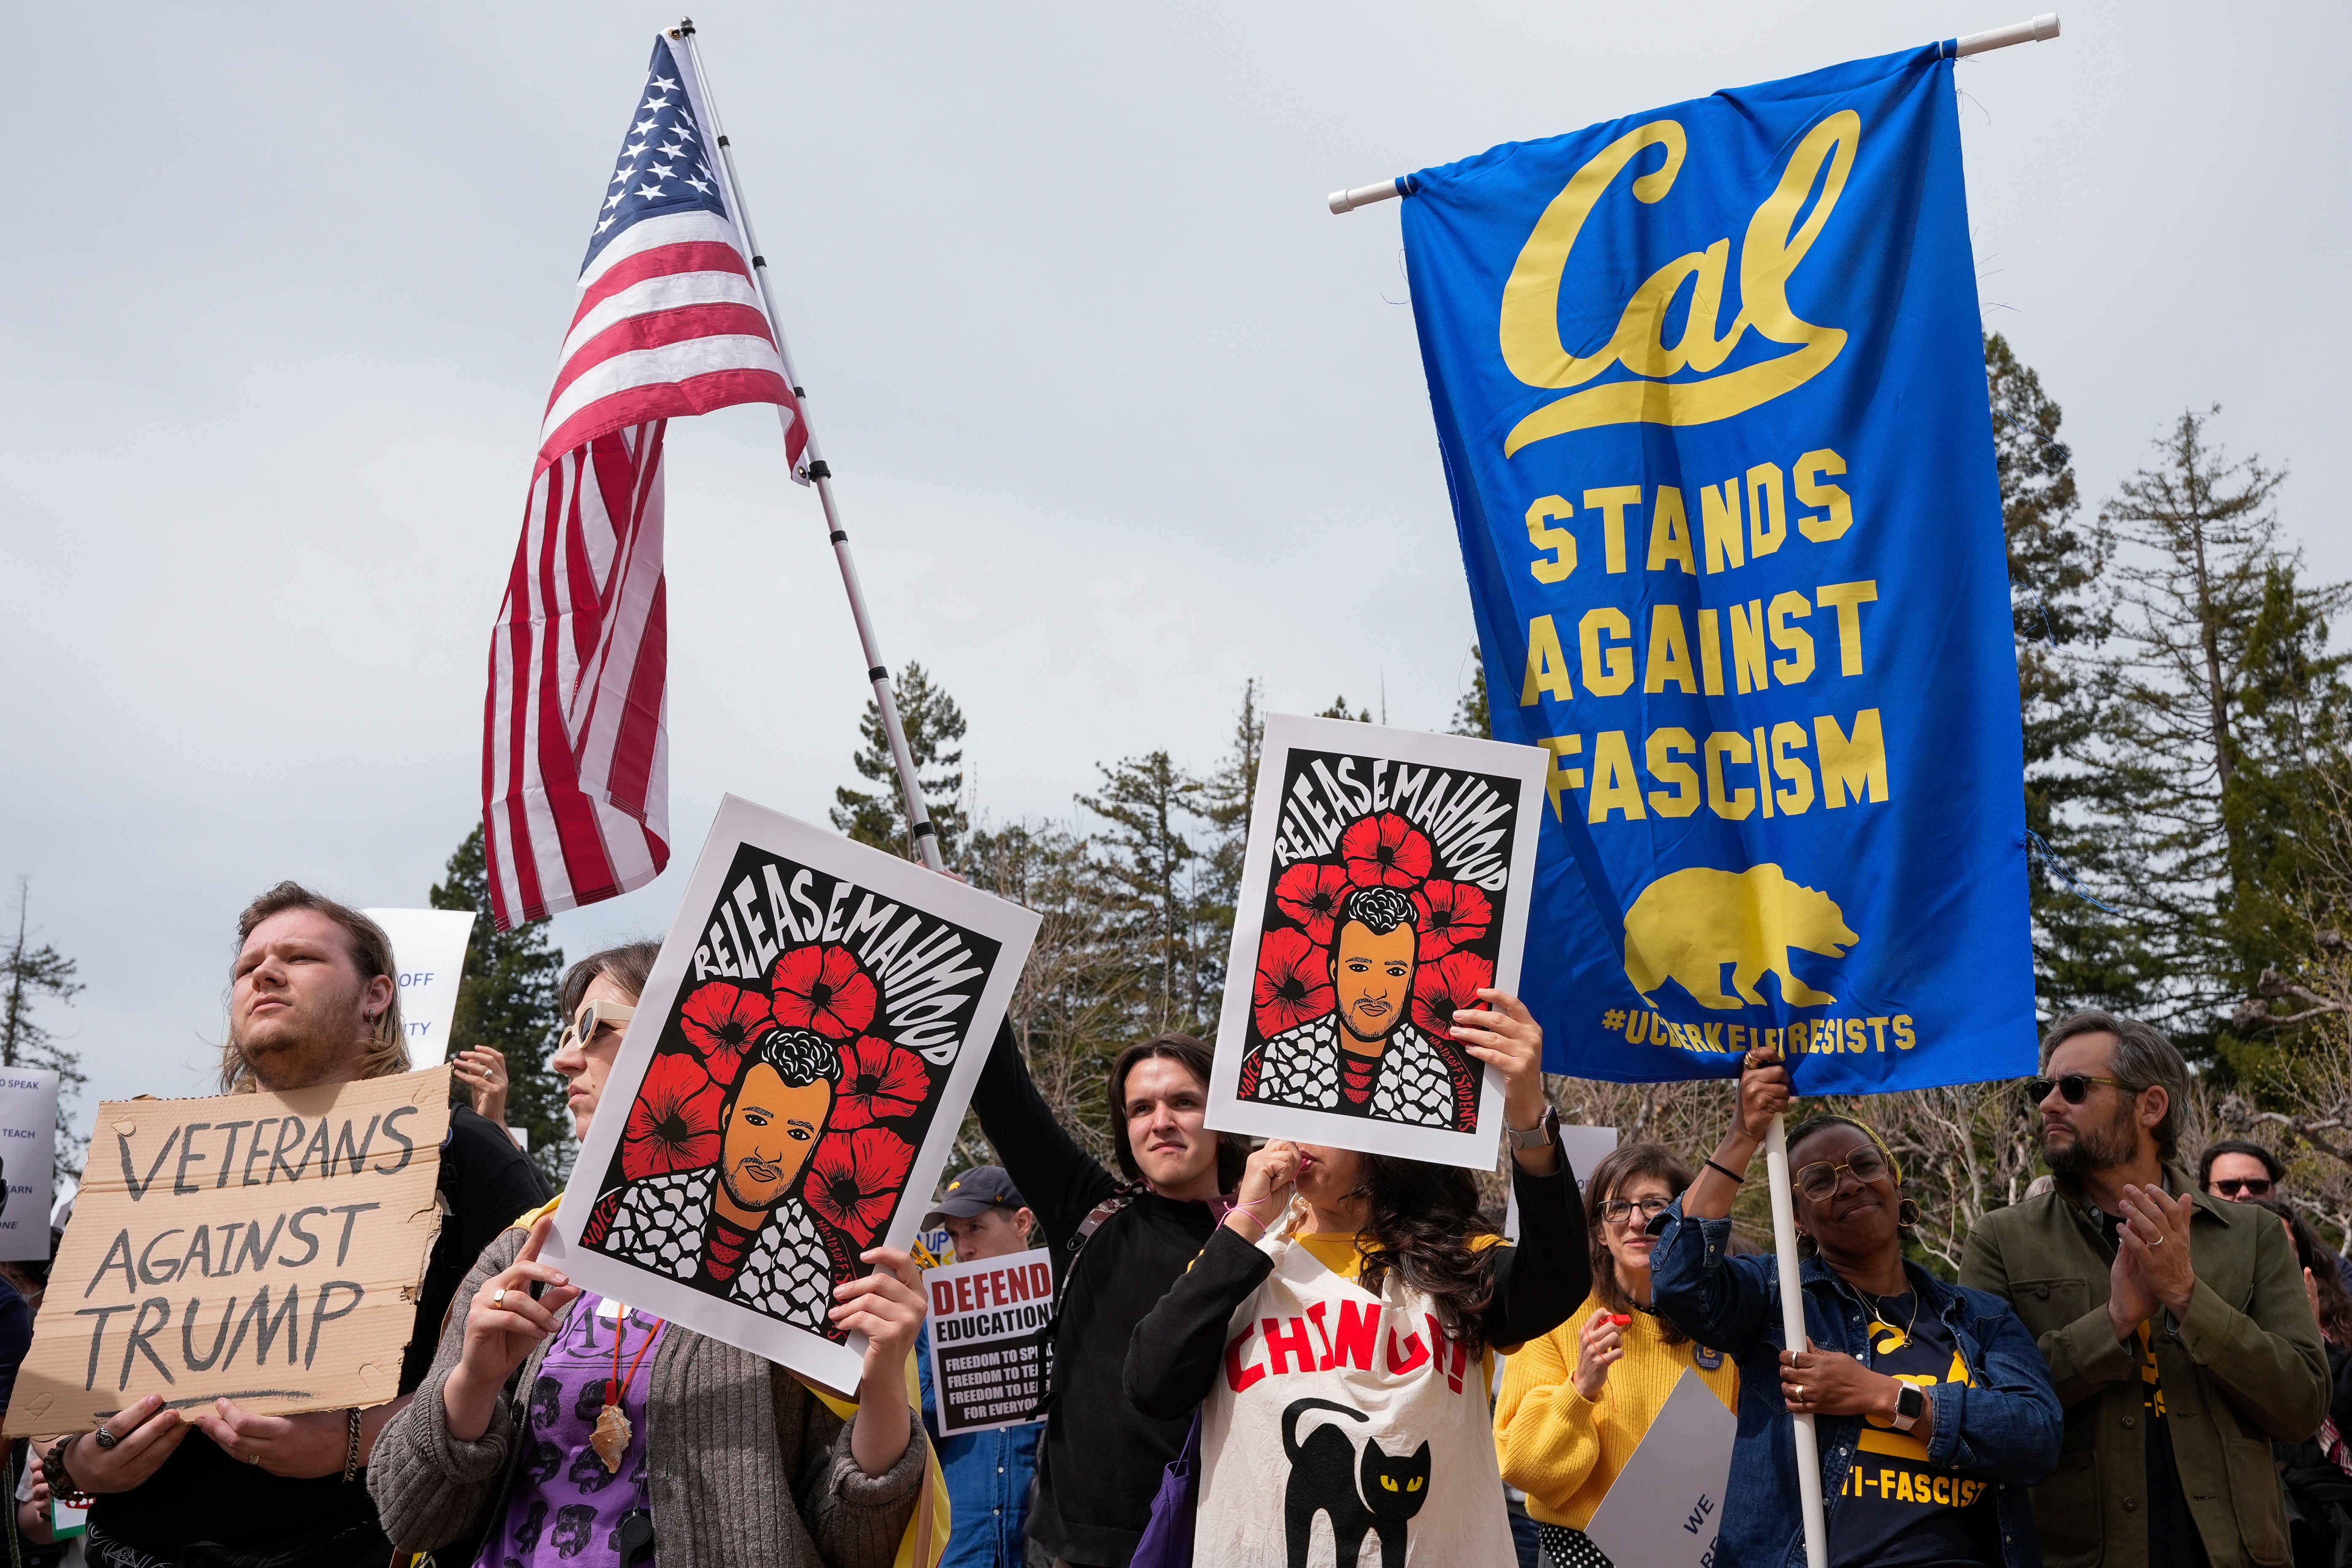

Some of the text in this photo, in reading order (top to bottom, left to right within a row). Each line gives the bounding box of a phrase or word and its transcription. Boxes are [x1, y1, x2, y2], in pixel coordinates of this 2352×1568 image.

[1500, 110, 1861, 458] Cal
[1526, 448, 1853, 584] STANDS
[1520, 580, 1878, 706] AGAINST
[1537, 708, 1889, 824] FASCISM
[399, 973, 435, 987] OFF
[8, 1080, 39, 1089] SPEAK
[3, 1128, 35, 1139] TEACH
[118, 1105, 420, 1201] VETERANS
[84, 1202, 380, 1299] AGAINST
[926, 1231, 948, 1252] UP
[932, 1263, 1051, 1316] DEFEND
[75, 1281, 364, 1393] TRUMP
[945, 1352, 1000, 1371] FREEDOM
[1001, 1349, 1018, 1363] TO
[947, 1369, 1002, 1388] FREEDOM
[1003, 1366, 1020, 1380] TO
[949, 1386, 1004, 1405] FREEDOM
[1005, 1383, 1021, 1397] TO
[964, 1405, 987, 1420] FOR
[1683, 1493, 1714, 1535] WE
